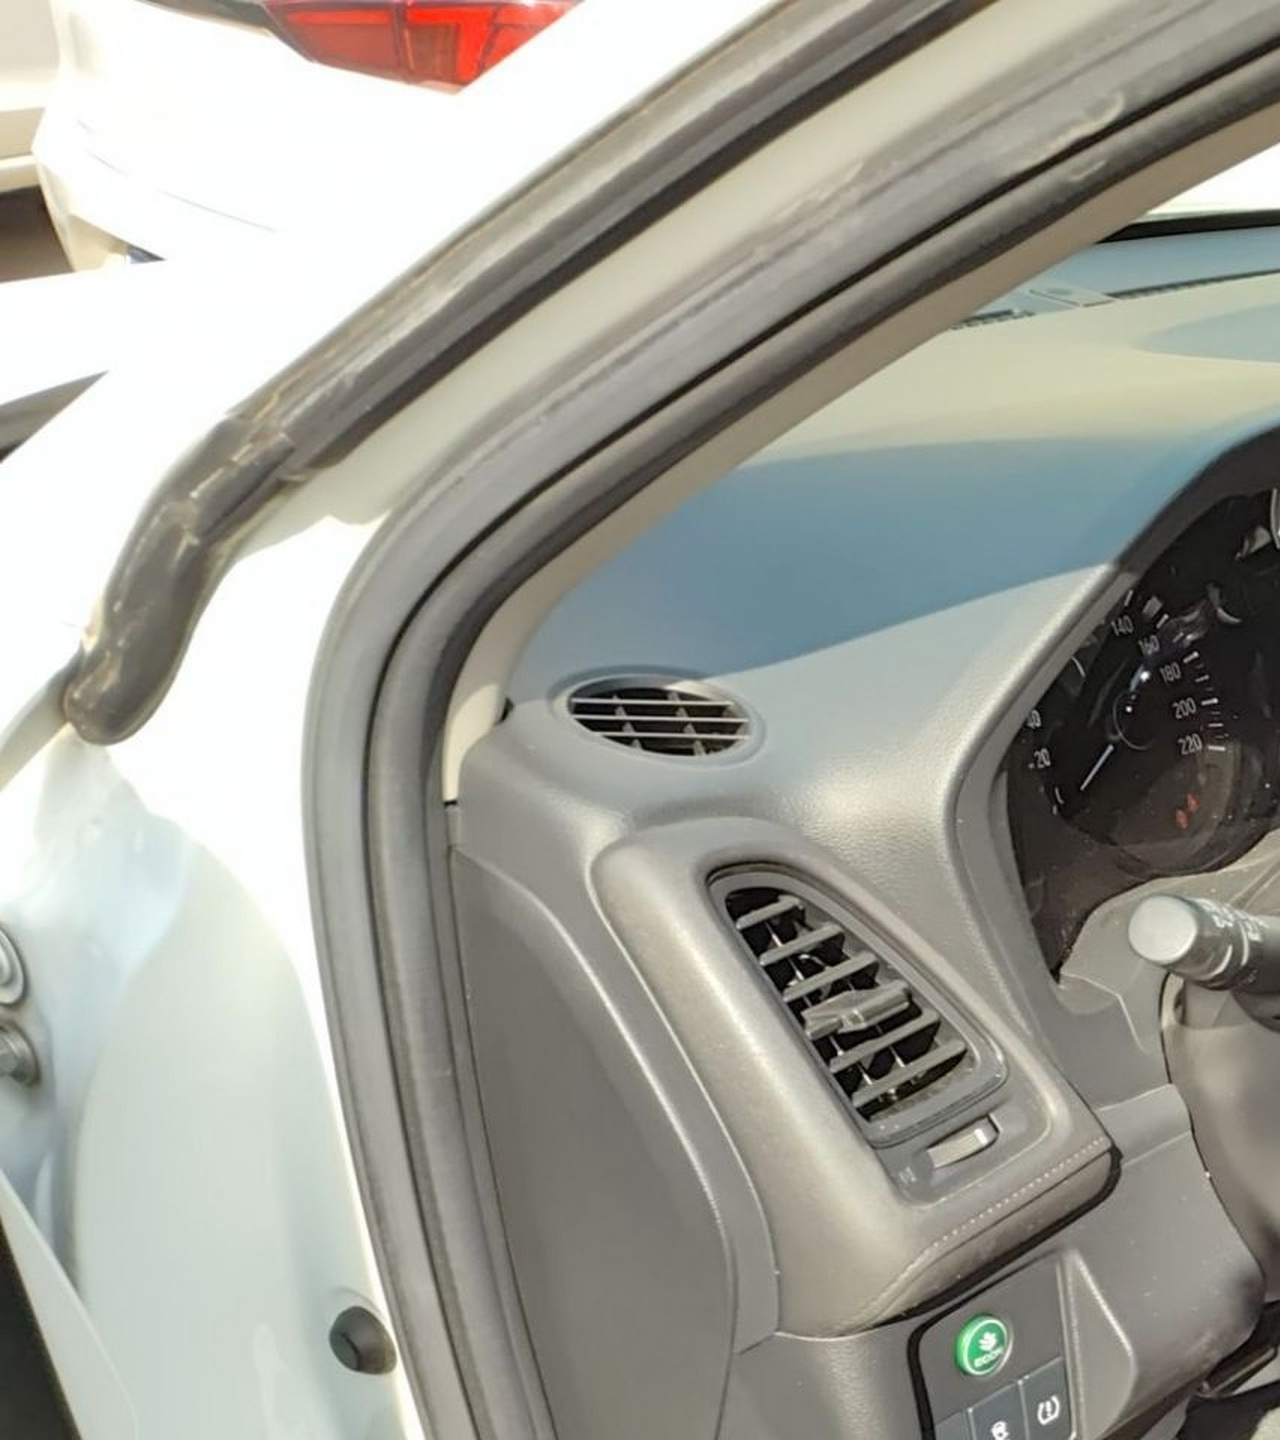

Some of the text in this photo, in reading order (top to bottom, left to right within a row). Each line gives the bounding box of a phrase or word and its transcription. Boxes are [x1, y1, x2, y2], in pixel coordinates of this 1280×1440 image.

[1111, 614, 1134, 636] 140
[1138, 634, 1160, 656] 160
[1159, 661, 1182, 684] 180
[1172, 697, 1197, 719] 200
[1177, 733, 1203, 756] 220
[1033, 747, 1052, 769] 20
